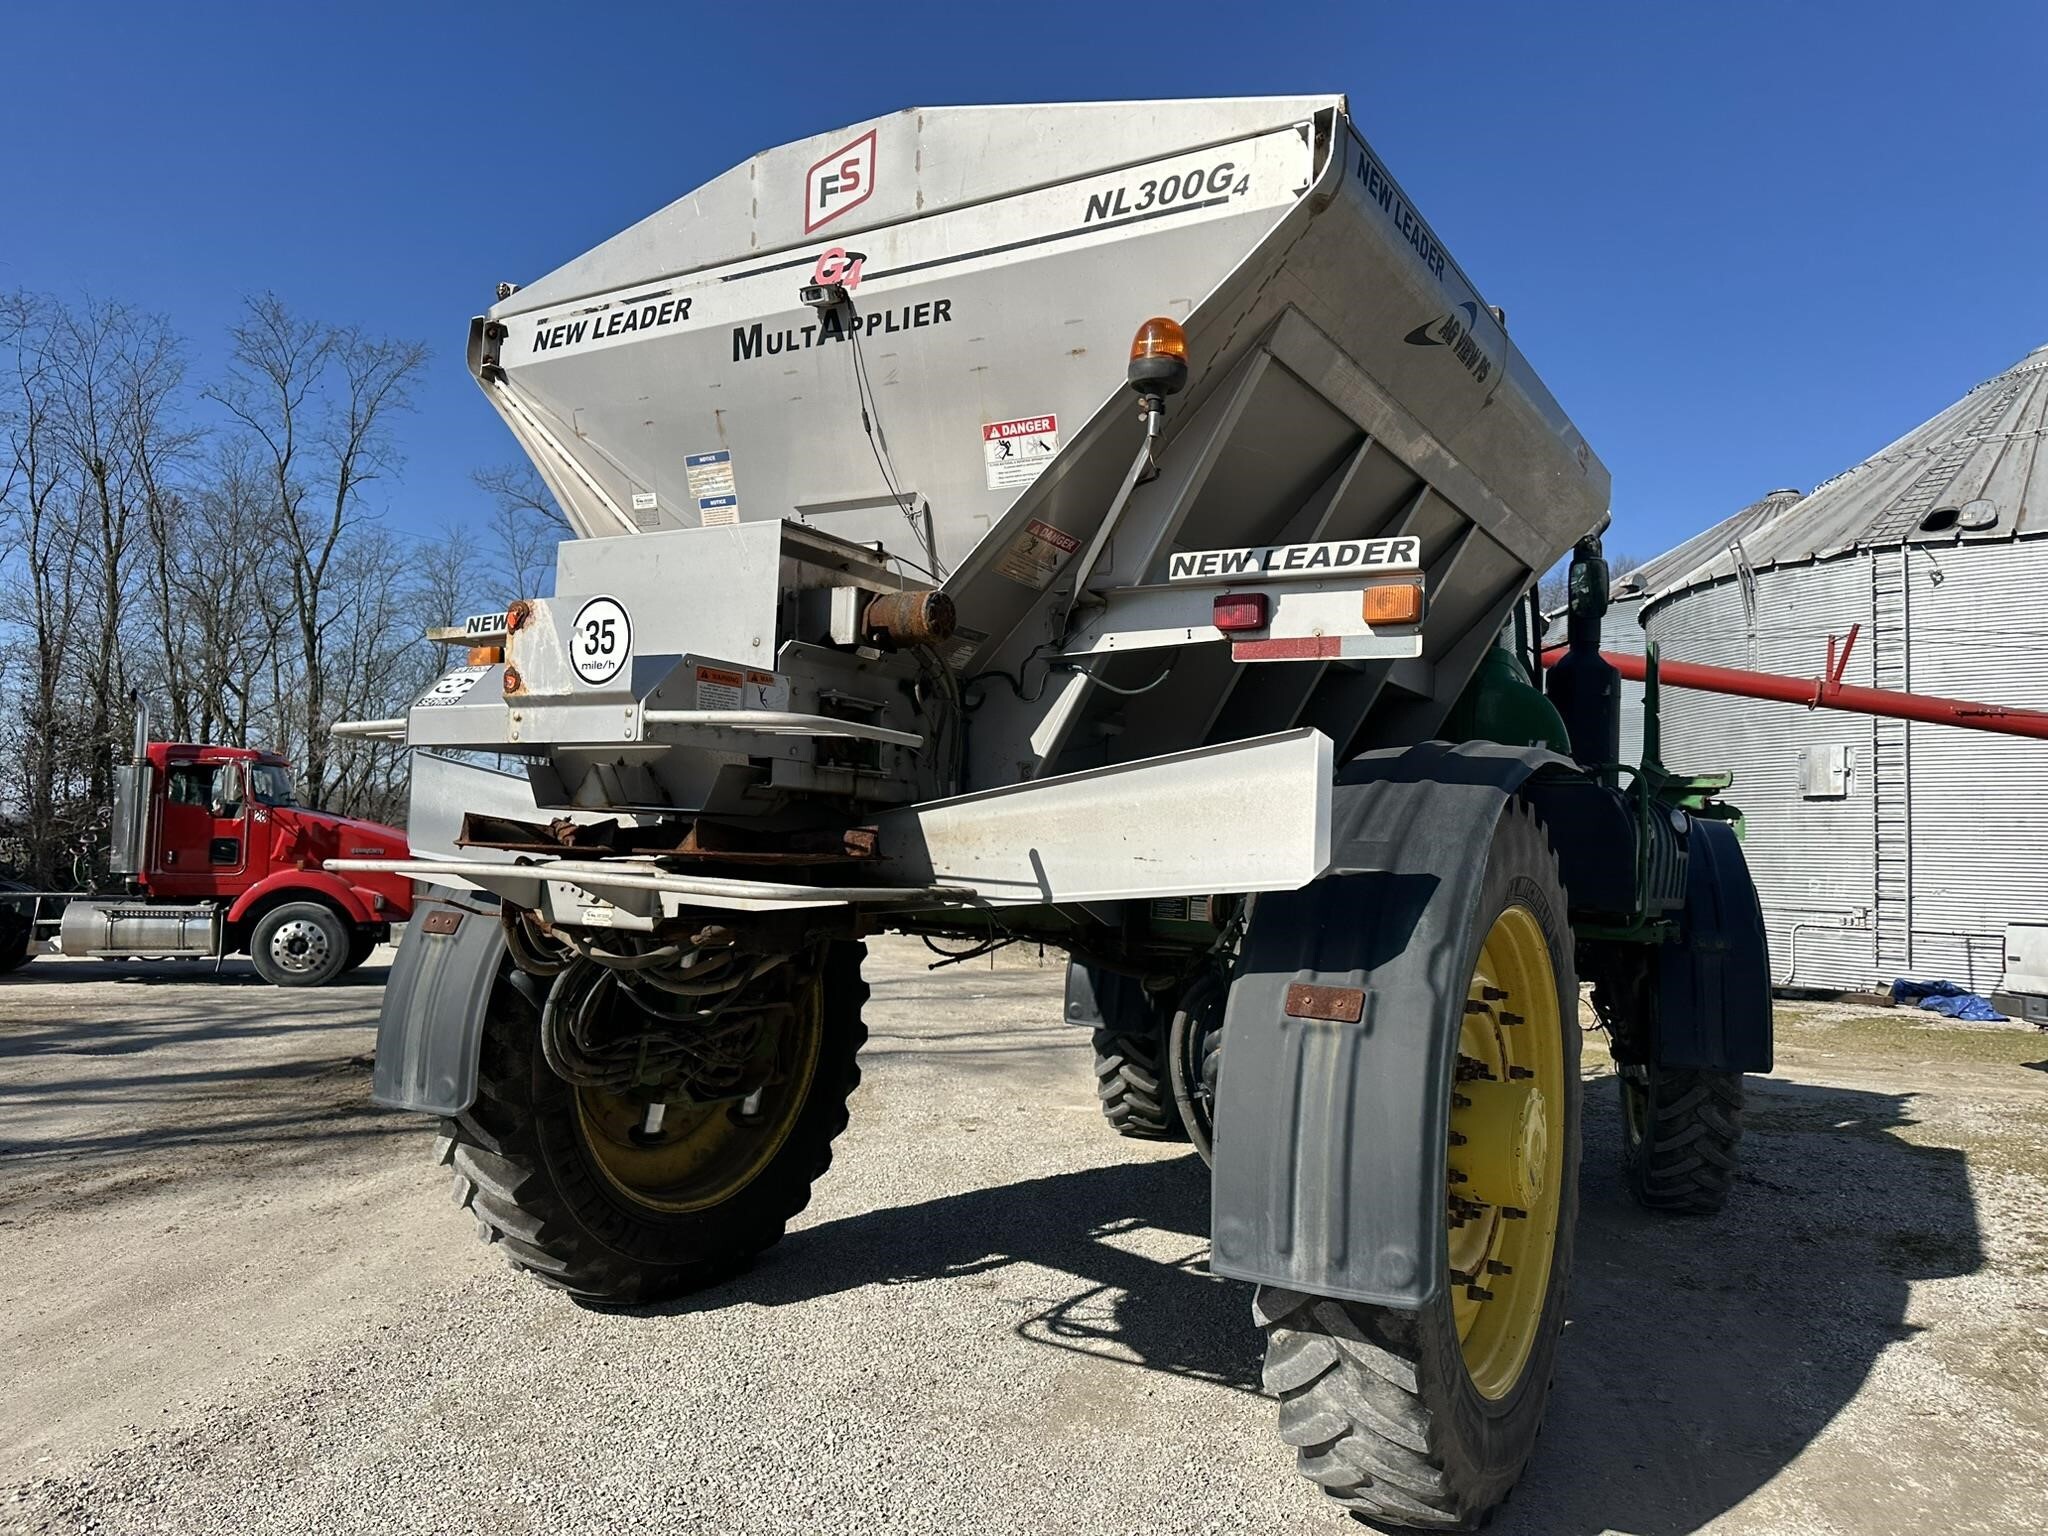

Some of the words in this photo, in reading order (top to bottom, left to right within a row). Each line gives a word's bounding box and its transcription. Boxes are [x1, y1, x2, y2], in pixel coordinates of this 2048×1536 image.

[820, 158, 860, 208] FS
[1084, 163, 1250, 222] NL300G4
[1357, 152, 1393, 213] NEW
[1394, 200, 1445, 282] LEADER
[815, 247, 863, 291] G4
[532, 319, 589, 353] NEW
[591, 297, 693, 341] LEADER
[1002, 418, 1051, 437] DANGER
[699, 455, 716, 463] NOTICE
[710, 498, 727, 506] NOTICE
[1039, 526, 1076, 551] DANGER
[1171, 550, 1252, 577] NEW
[1262, 539, 1416, 571] LEADER
[467, 612, 509, 634] NEW
[584, 619, 616, 655] 35
[581, 658, 616, 671] mile/h
